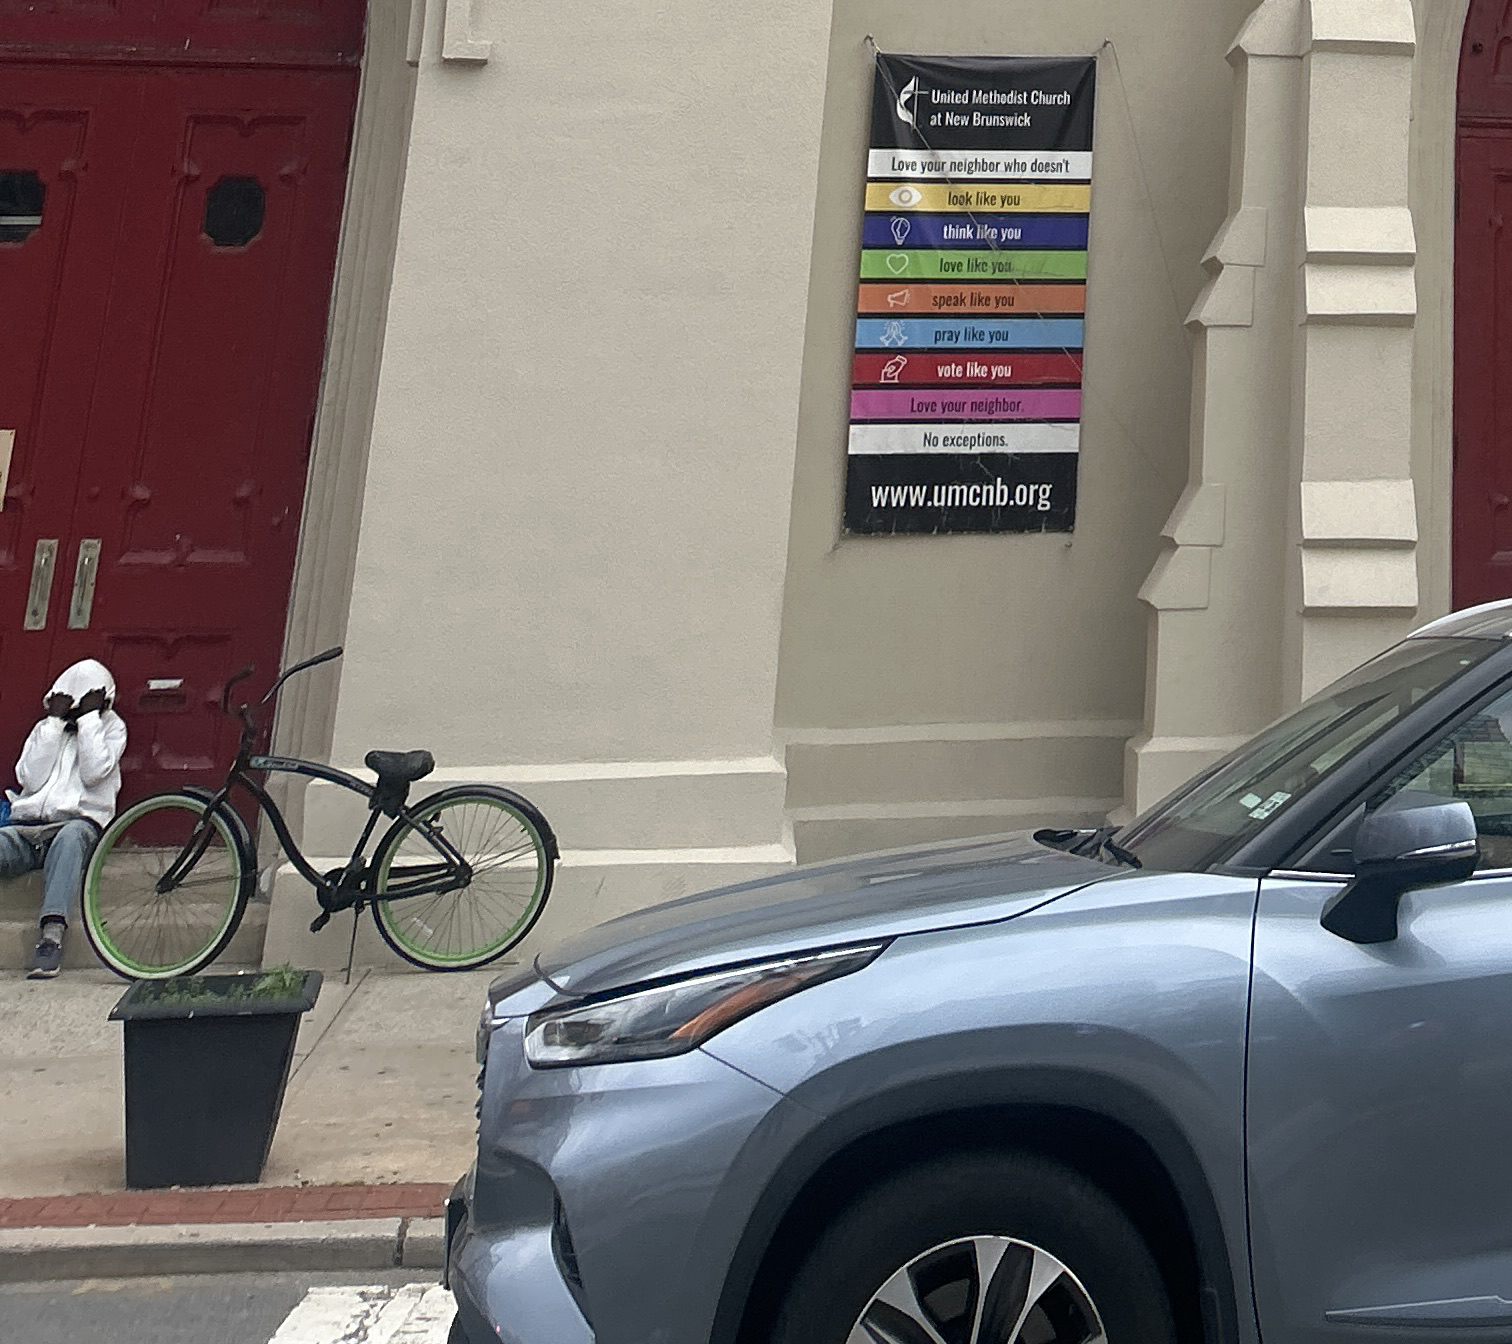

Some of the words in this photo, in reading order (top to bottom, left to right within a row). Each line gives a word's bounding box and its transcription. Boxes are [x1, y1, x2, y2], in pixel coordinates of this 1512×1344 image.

[931, 89, 969, 105] United
[972, 89, 1029, 105] Methodist
[1030, 90, 1071, 106] Church
[930, 114, 942, 127] at
[945, 112, 970, 127] New
[972, 112, 1032, 128] Brunswick
[891, 156, 917, 172] Love
[920, 160, 946, 174] your
[949, 156, 1001, 174] neighbor
[1004, 158, 1027, 173] who
[1030, 158, 1070, 174] doesn't
[947, 191, 972, 206] look
[975, 191, 997, 207] like
[1000, 195, 1021, 210] you
[943, 224, 973, 240] think
[976, 225, 998, 240] like
[1000, 227, 1022, 243] you
[939, 258, 964, 273] love
[966, 258, 988, 273] like
[990, 261, 1012, 276] you
[932, 291, 967, 309] speak
[969, 291, 991, 307] like
[994, 294, 1015, 309] you
[934, 329, 960, 344] pray
[963, 326, 985, 342] like
[988, 330, 1009, 345] you
[937, 363, 963, 378] vote
[966, 362, 988, 378] like
[990, 365, 1012, 379] you
[910, 397, 938, 413] Love
[941, 400, 967, 414] your
[970, 397, 1025, 414] neighbor.
[923, 432, 939, 447] No
[942, 432, 1009, 450] exceptions.
[870, 477, 1053, 511] www.umcnb.org
